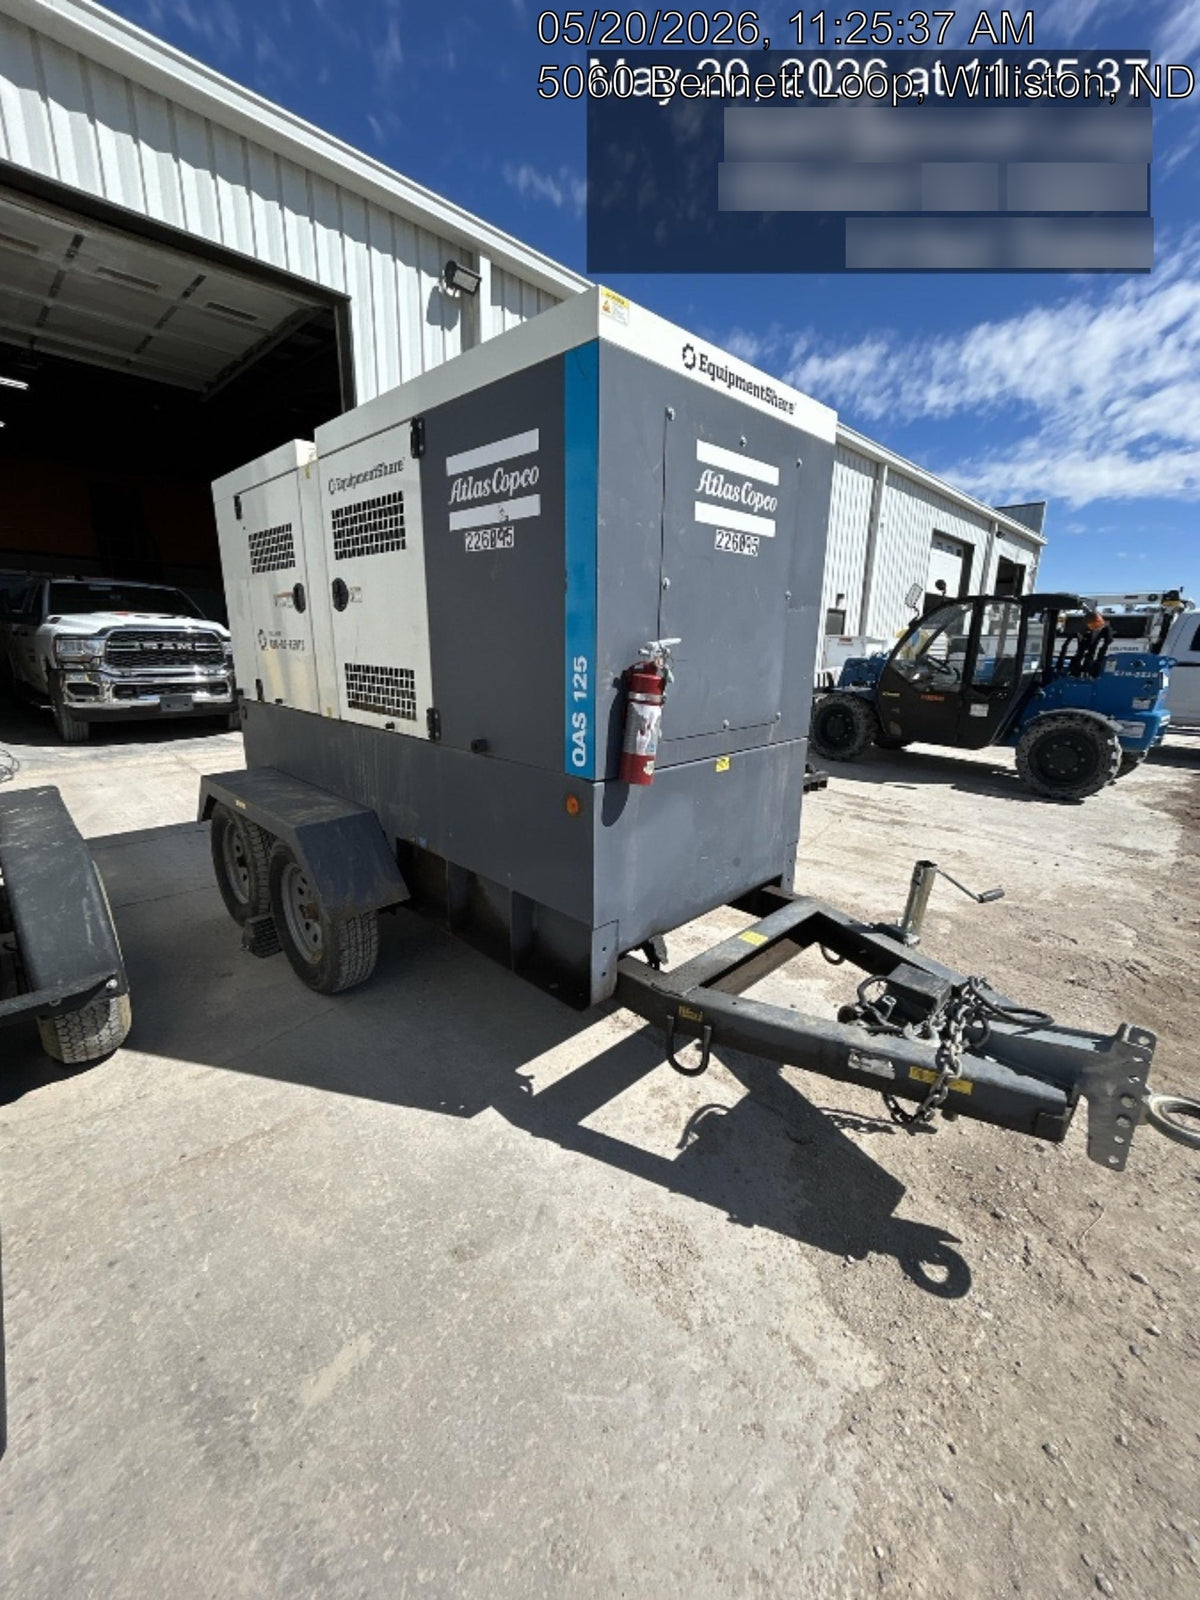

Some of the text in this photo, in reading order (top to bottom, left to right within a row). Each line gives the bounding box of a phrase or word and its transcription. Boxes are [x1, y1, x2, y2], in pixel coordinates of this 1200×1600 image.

[698, 353, 797, 415] EquipmentShare
[447, 465, 540, 505] Atlas Copco
[694, 468, 778, 513] Atlas Copco
[572, 655, 589, 702] 125
